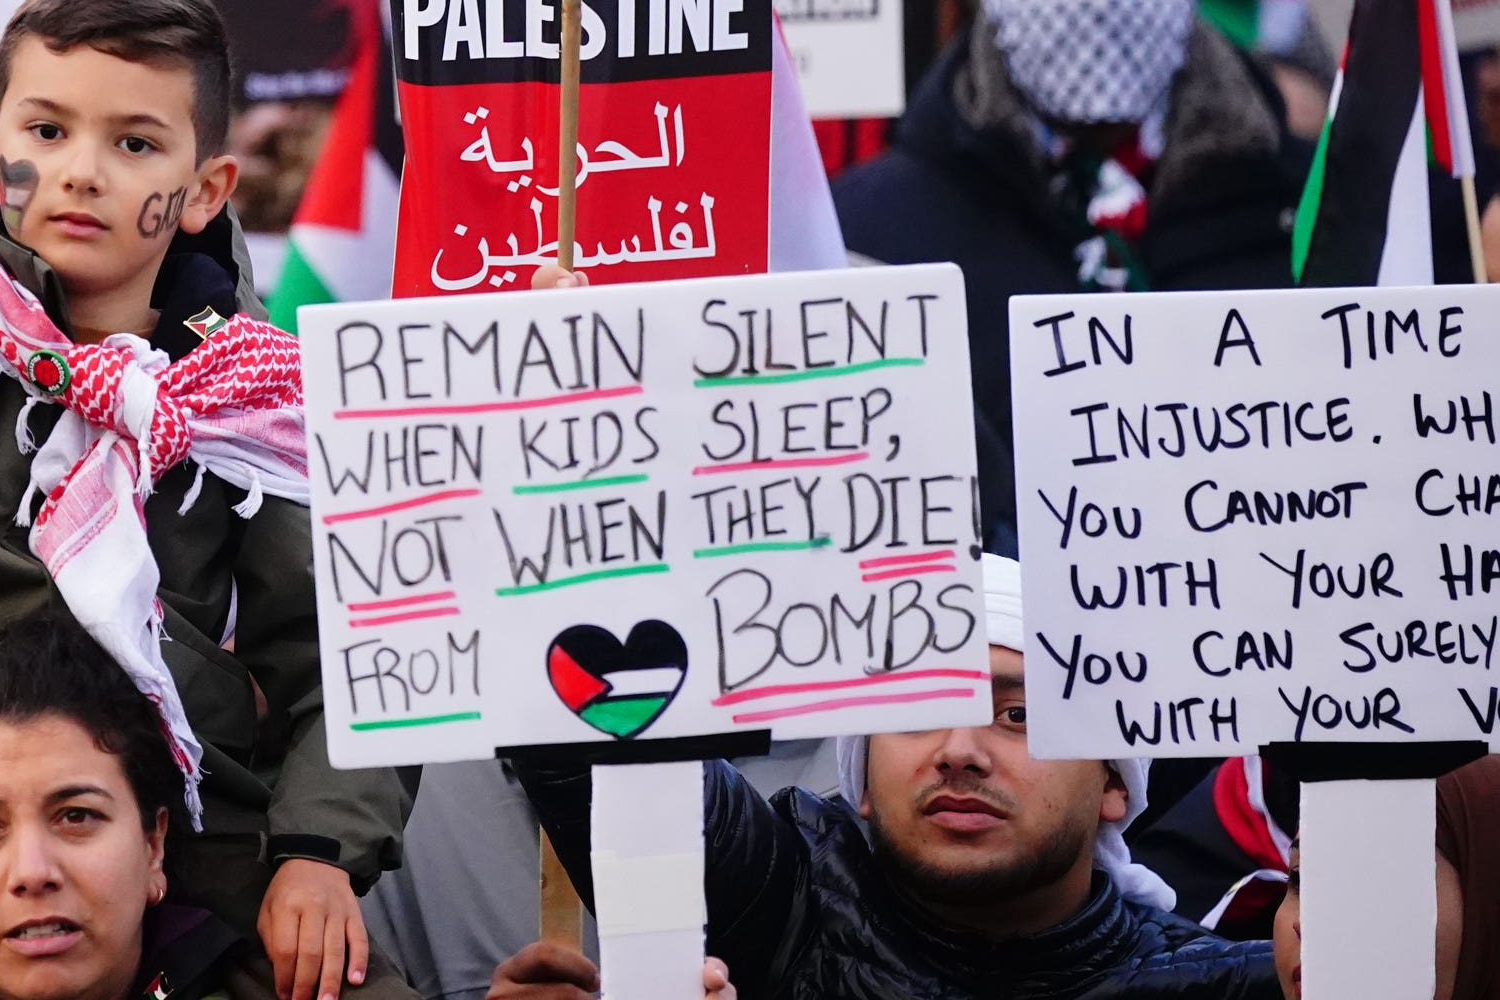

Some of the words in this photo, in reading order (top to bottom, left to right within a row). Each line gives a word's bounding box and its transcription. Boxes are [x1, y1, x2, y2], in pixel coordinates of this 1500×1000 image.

[459, 100, 685, 197] الحرية
[335, 307, 645, 408] REMAIN
[693, 294, 940, 379] SILENT
[1033, 310, 1133, 377] IN
[1213, 308, 1262, 367] A
[1321, 302, 1464, 369] TIME
[316, 424, 483, 495] WHEN
[519, 406, 660, 480] KIDS
[701, 387, 901, 463] SLEEP,
[327, 515, 463, 602] NOT
[492, 490, 667, 586] WHEN
[691, 475, 821, 544] THEY
[839, 472, 983, 562] DIE!
[1184, 479, 1368, 532] CANNOT
[1070, 558, 1221, 610] WITH
[1259, 549, 1403, 609] YOUR
[340, 629, 480, 715] FROM
[705, 567, 976, 695] BOMBS
[1193, 628, 1293, 677] CAN
[1339, 615, 1498, 673] SURELY
[1115, 697, 1240, 746] WITH
[1278, 685, 1415, 741] YOUR
[1457, 685, 1500, 735] V
